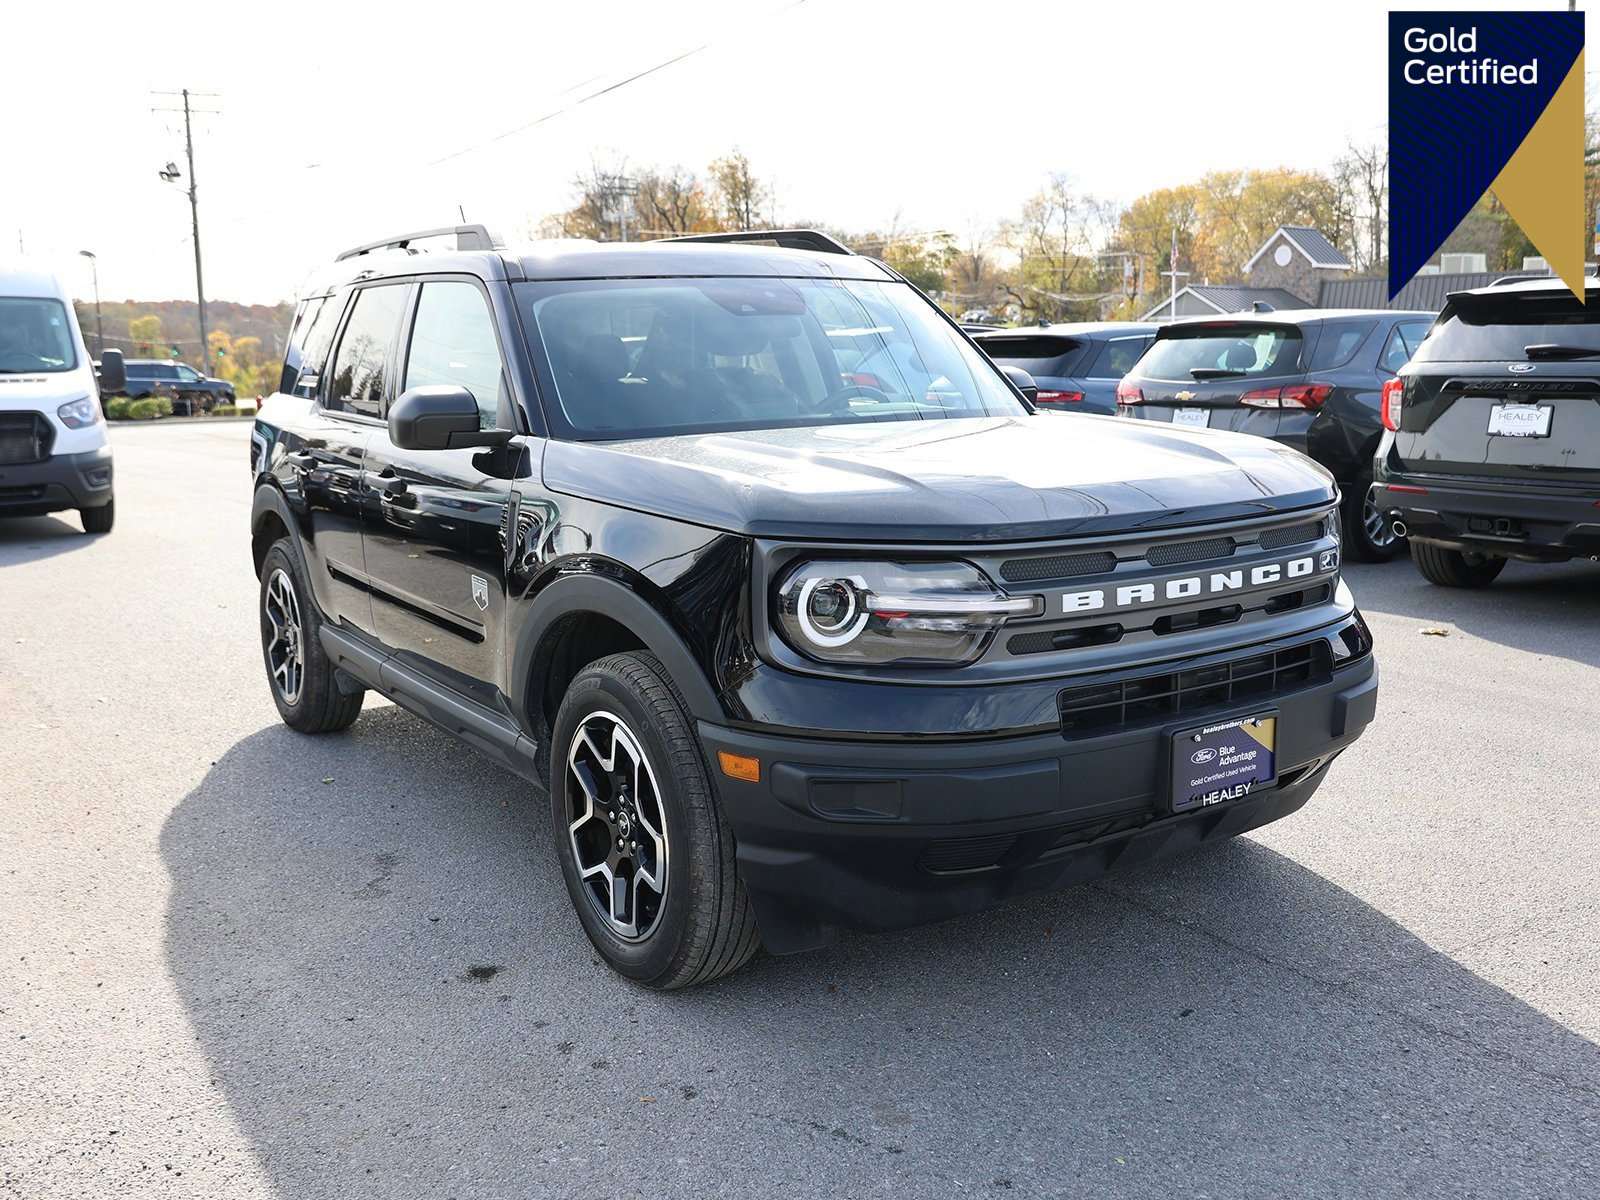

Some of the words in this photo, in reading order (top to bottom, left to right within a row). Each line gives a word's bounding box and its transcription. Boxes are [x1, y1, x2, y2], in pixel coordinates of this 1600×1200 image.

[1498, 413, 1542, 421] HEALEY
[1062, 557, 1314, 613] BRONCO
[1202, 717, 1256, 734] healeybrothers.com
[1219, 745, 1236, 756] Blue
[1219, 750, 1257, 767] Advantage
[1190, 778, 1204, 786] Gold
[1204, 771, 1225, 784] Certified
[1225, 767, 1239, 777] Used
[1239, 764, 1257, 773] Vehicle
[1202, 782, 1252, 806] HEALEY
